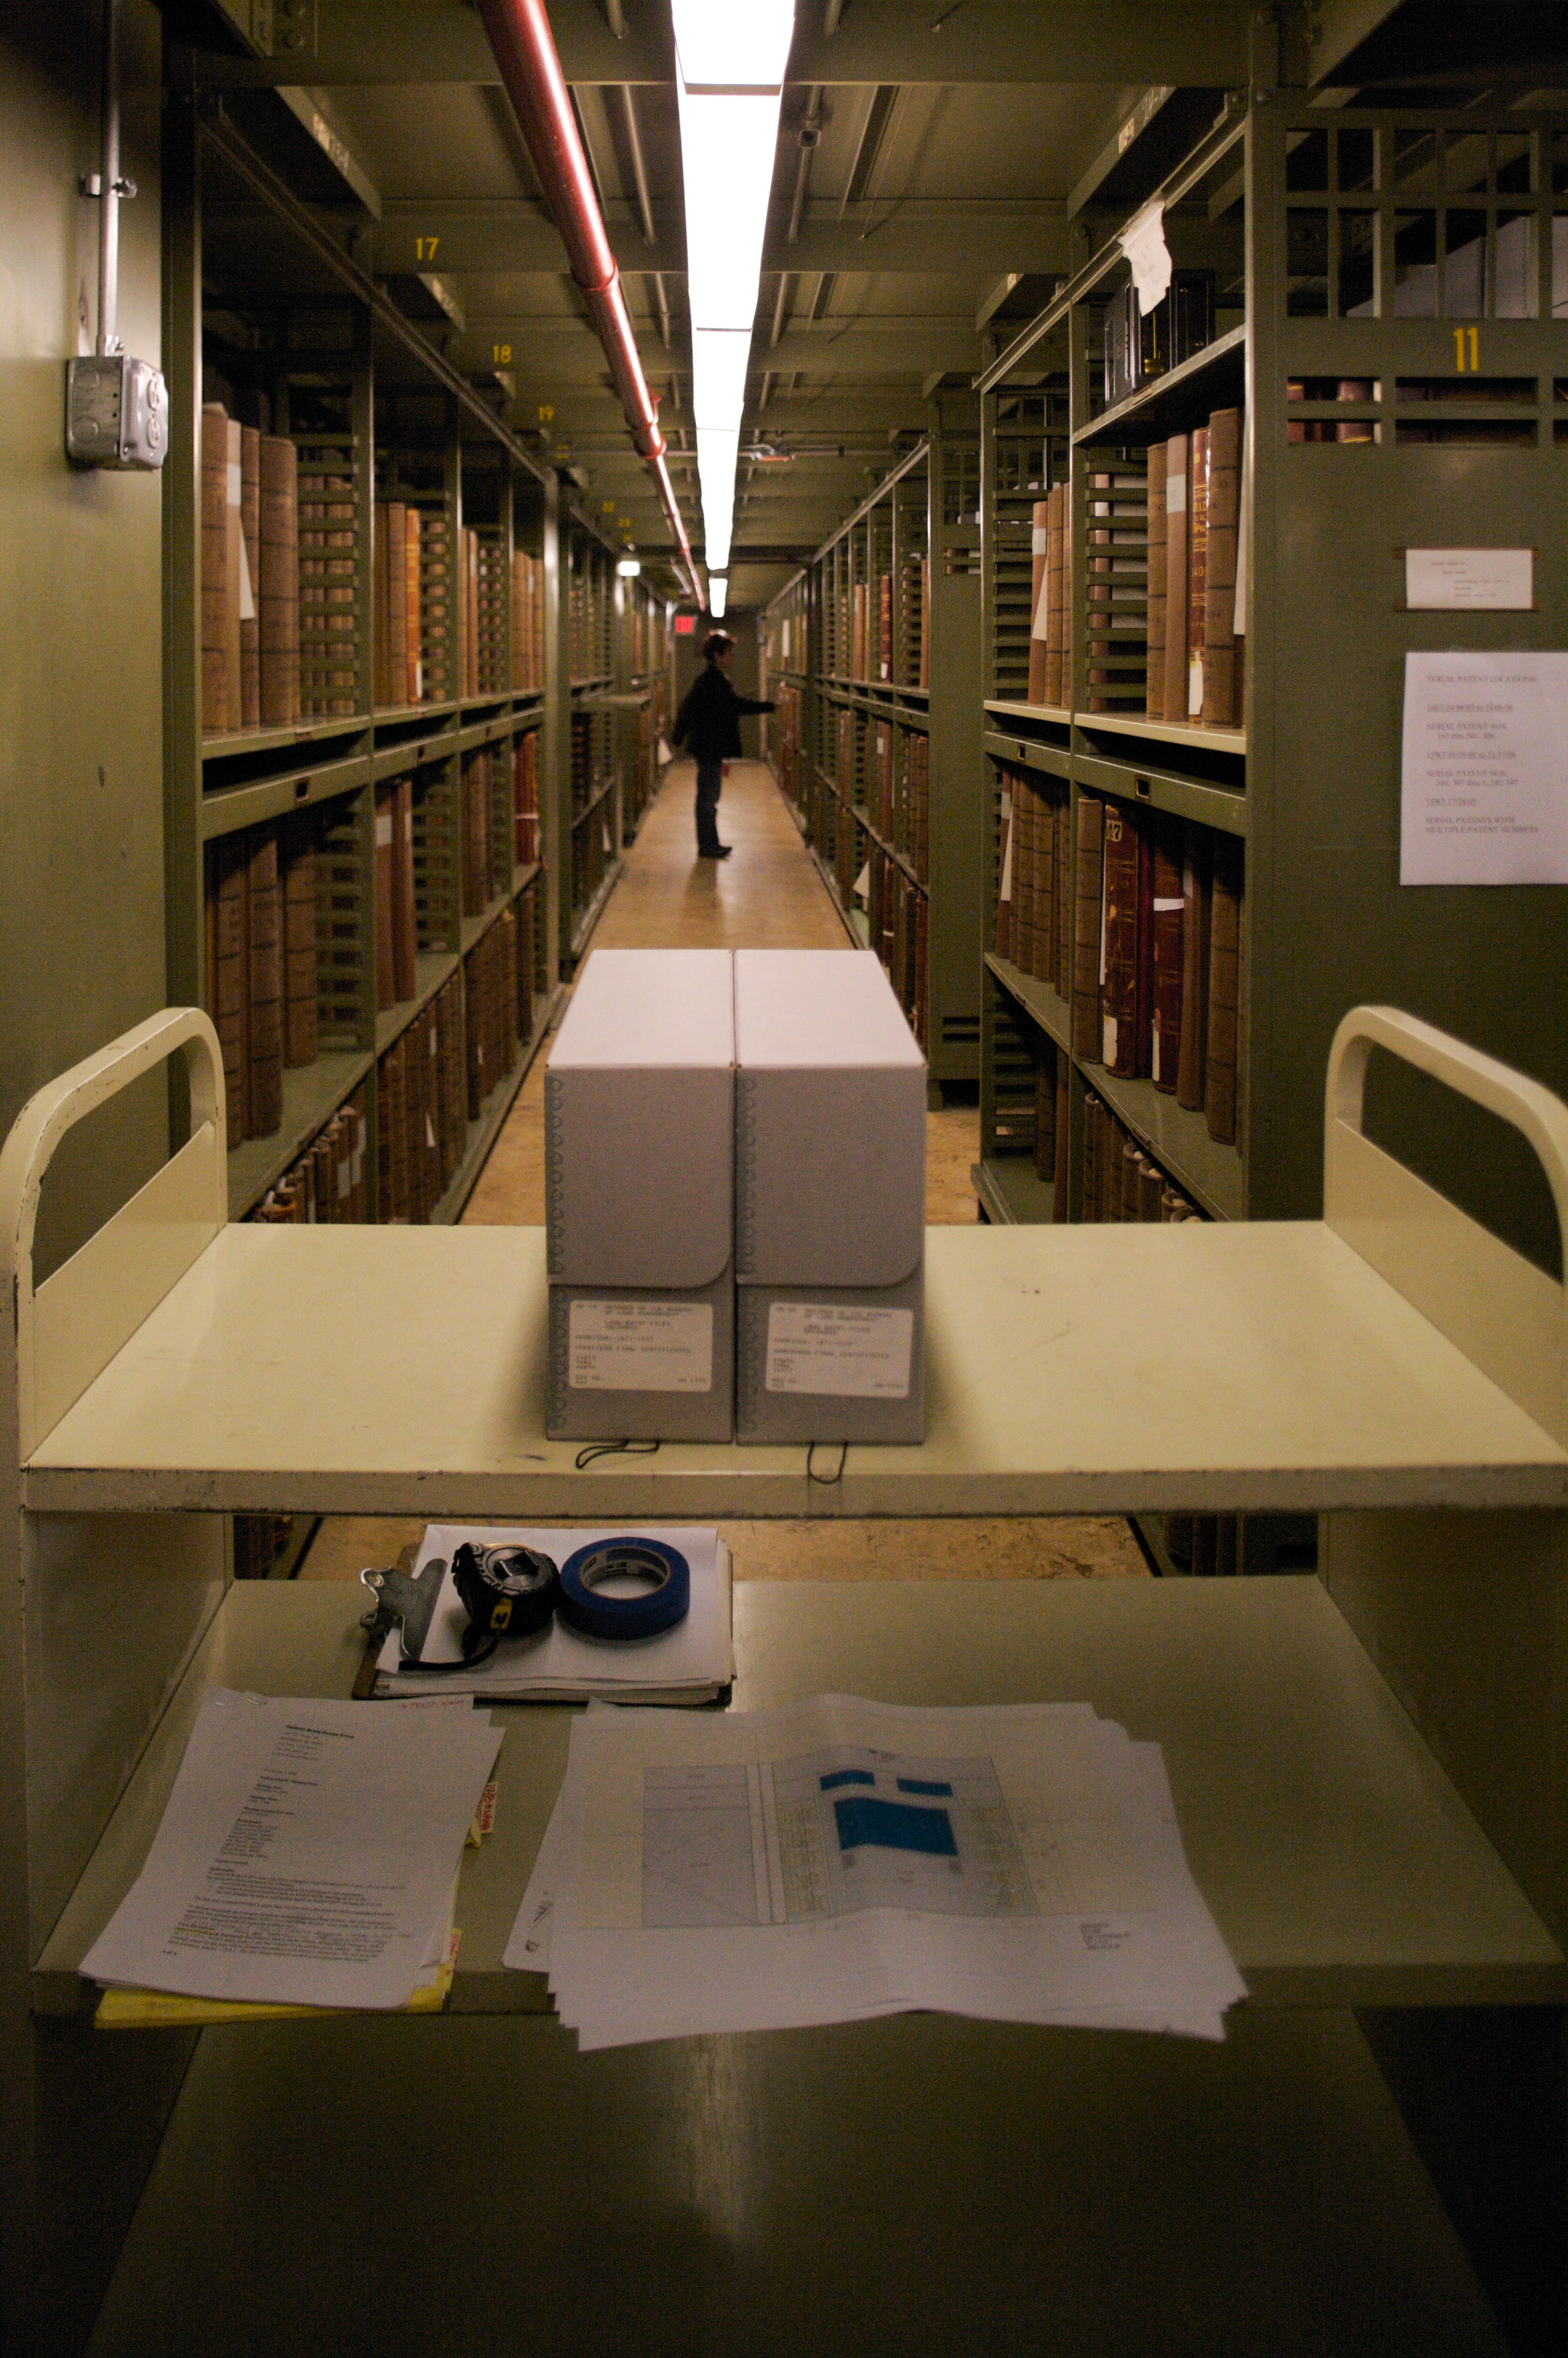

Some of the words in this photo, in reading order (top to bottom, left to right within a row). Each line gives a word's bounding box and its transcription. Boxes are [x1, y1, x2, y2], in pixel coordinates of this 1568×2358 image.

[416, 237, 440, 261] 17
[492, 345, 511, 363] 18
[1453, 326, 1478, 373] 11
[538, 405, 554, 420] 19
[1426, 675, 1455, 683] SERIAL
[1457, 675, 1488, 683] PATENT
